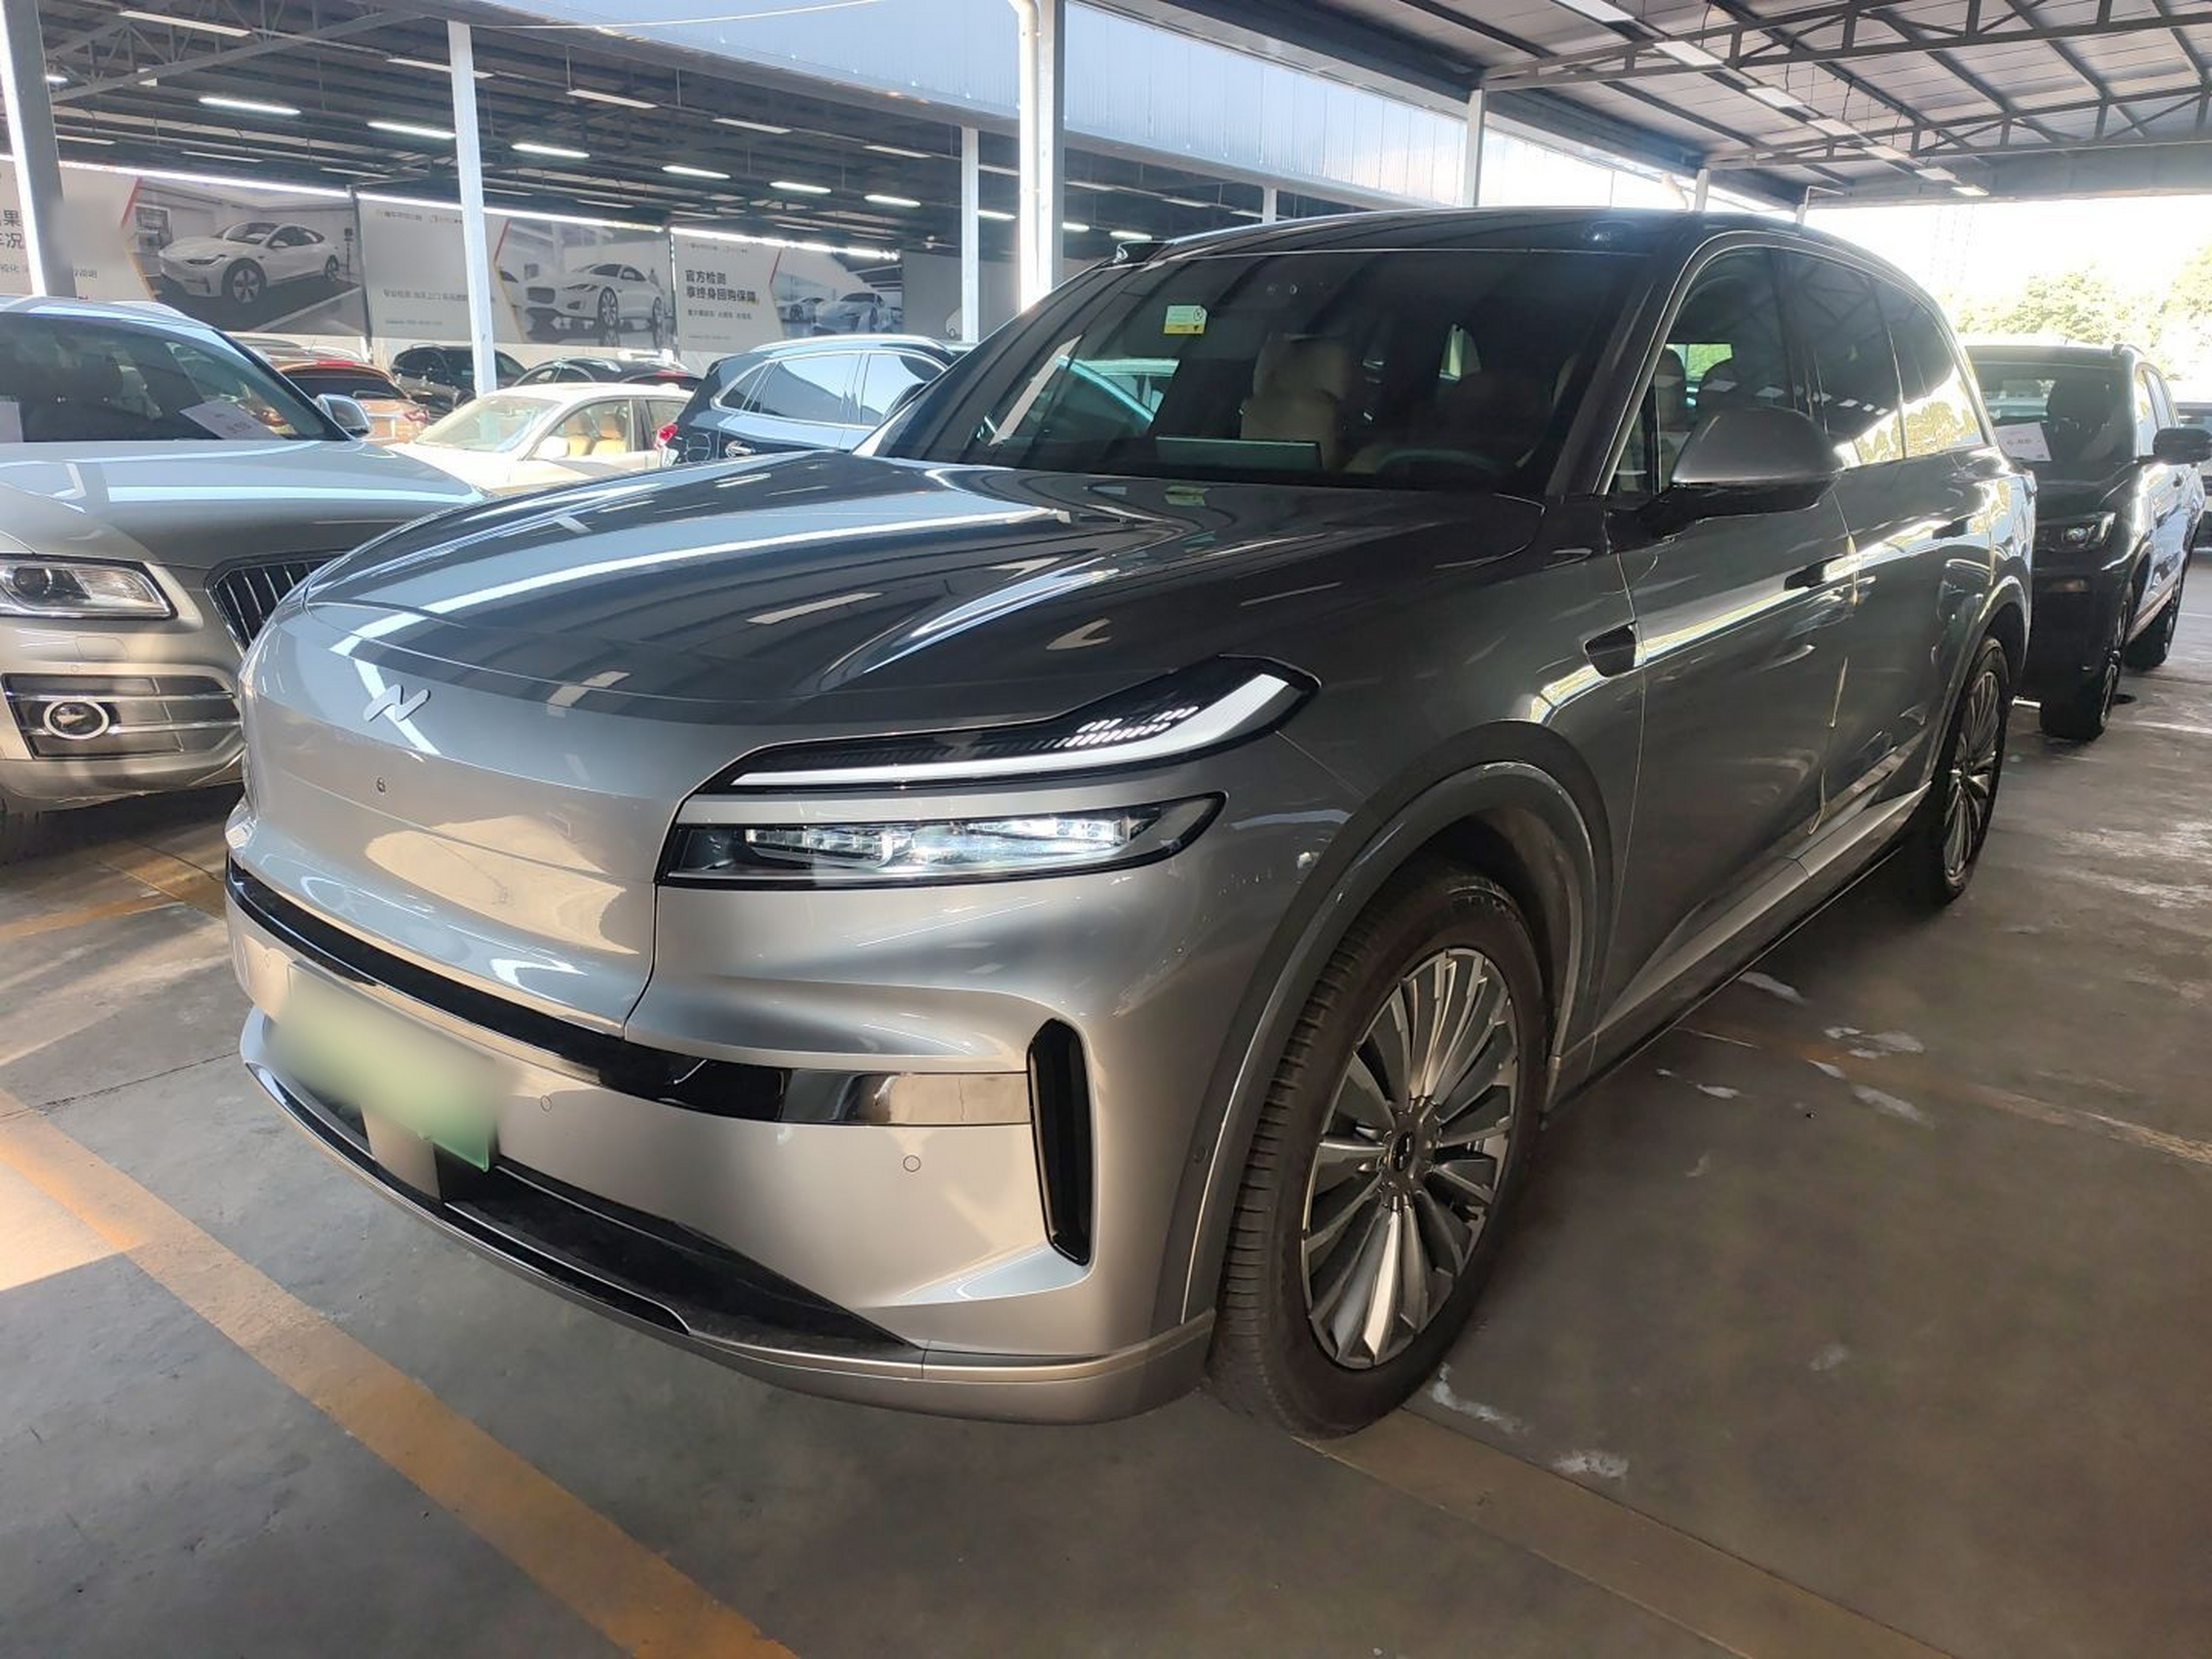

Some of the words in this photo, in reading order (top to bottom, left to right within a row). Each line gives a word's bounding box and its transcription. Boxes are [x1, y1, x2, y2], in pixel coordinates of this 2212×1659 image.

[0, 209, 21, 227] 果
[685, 270, 726, 285] 官方检测
